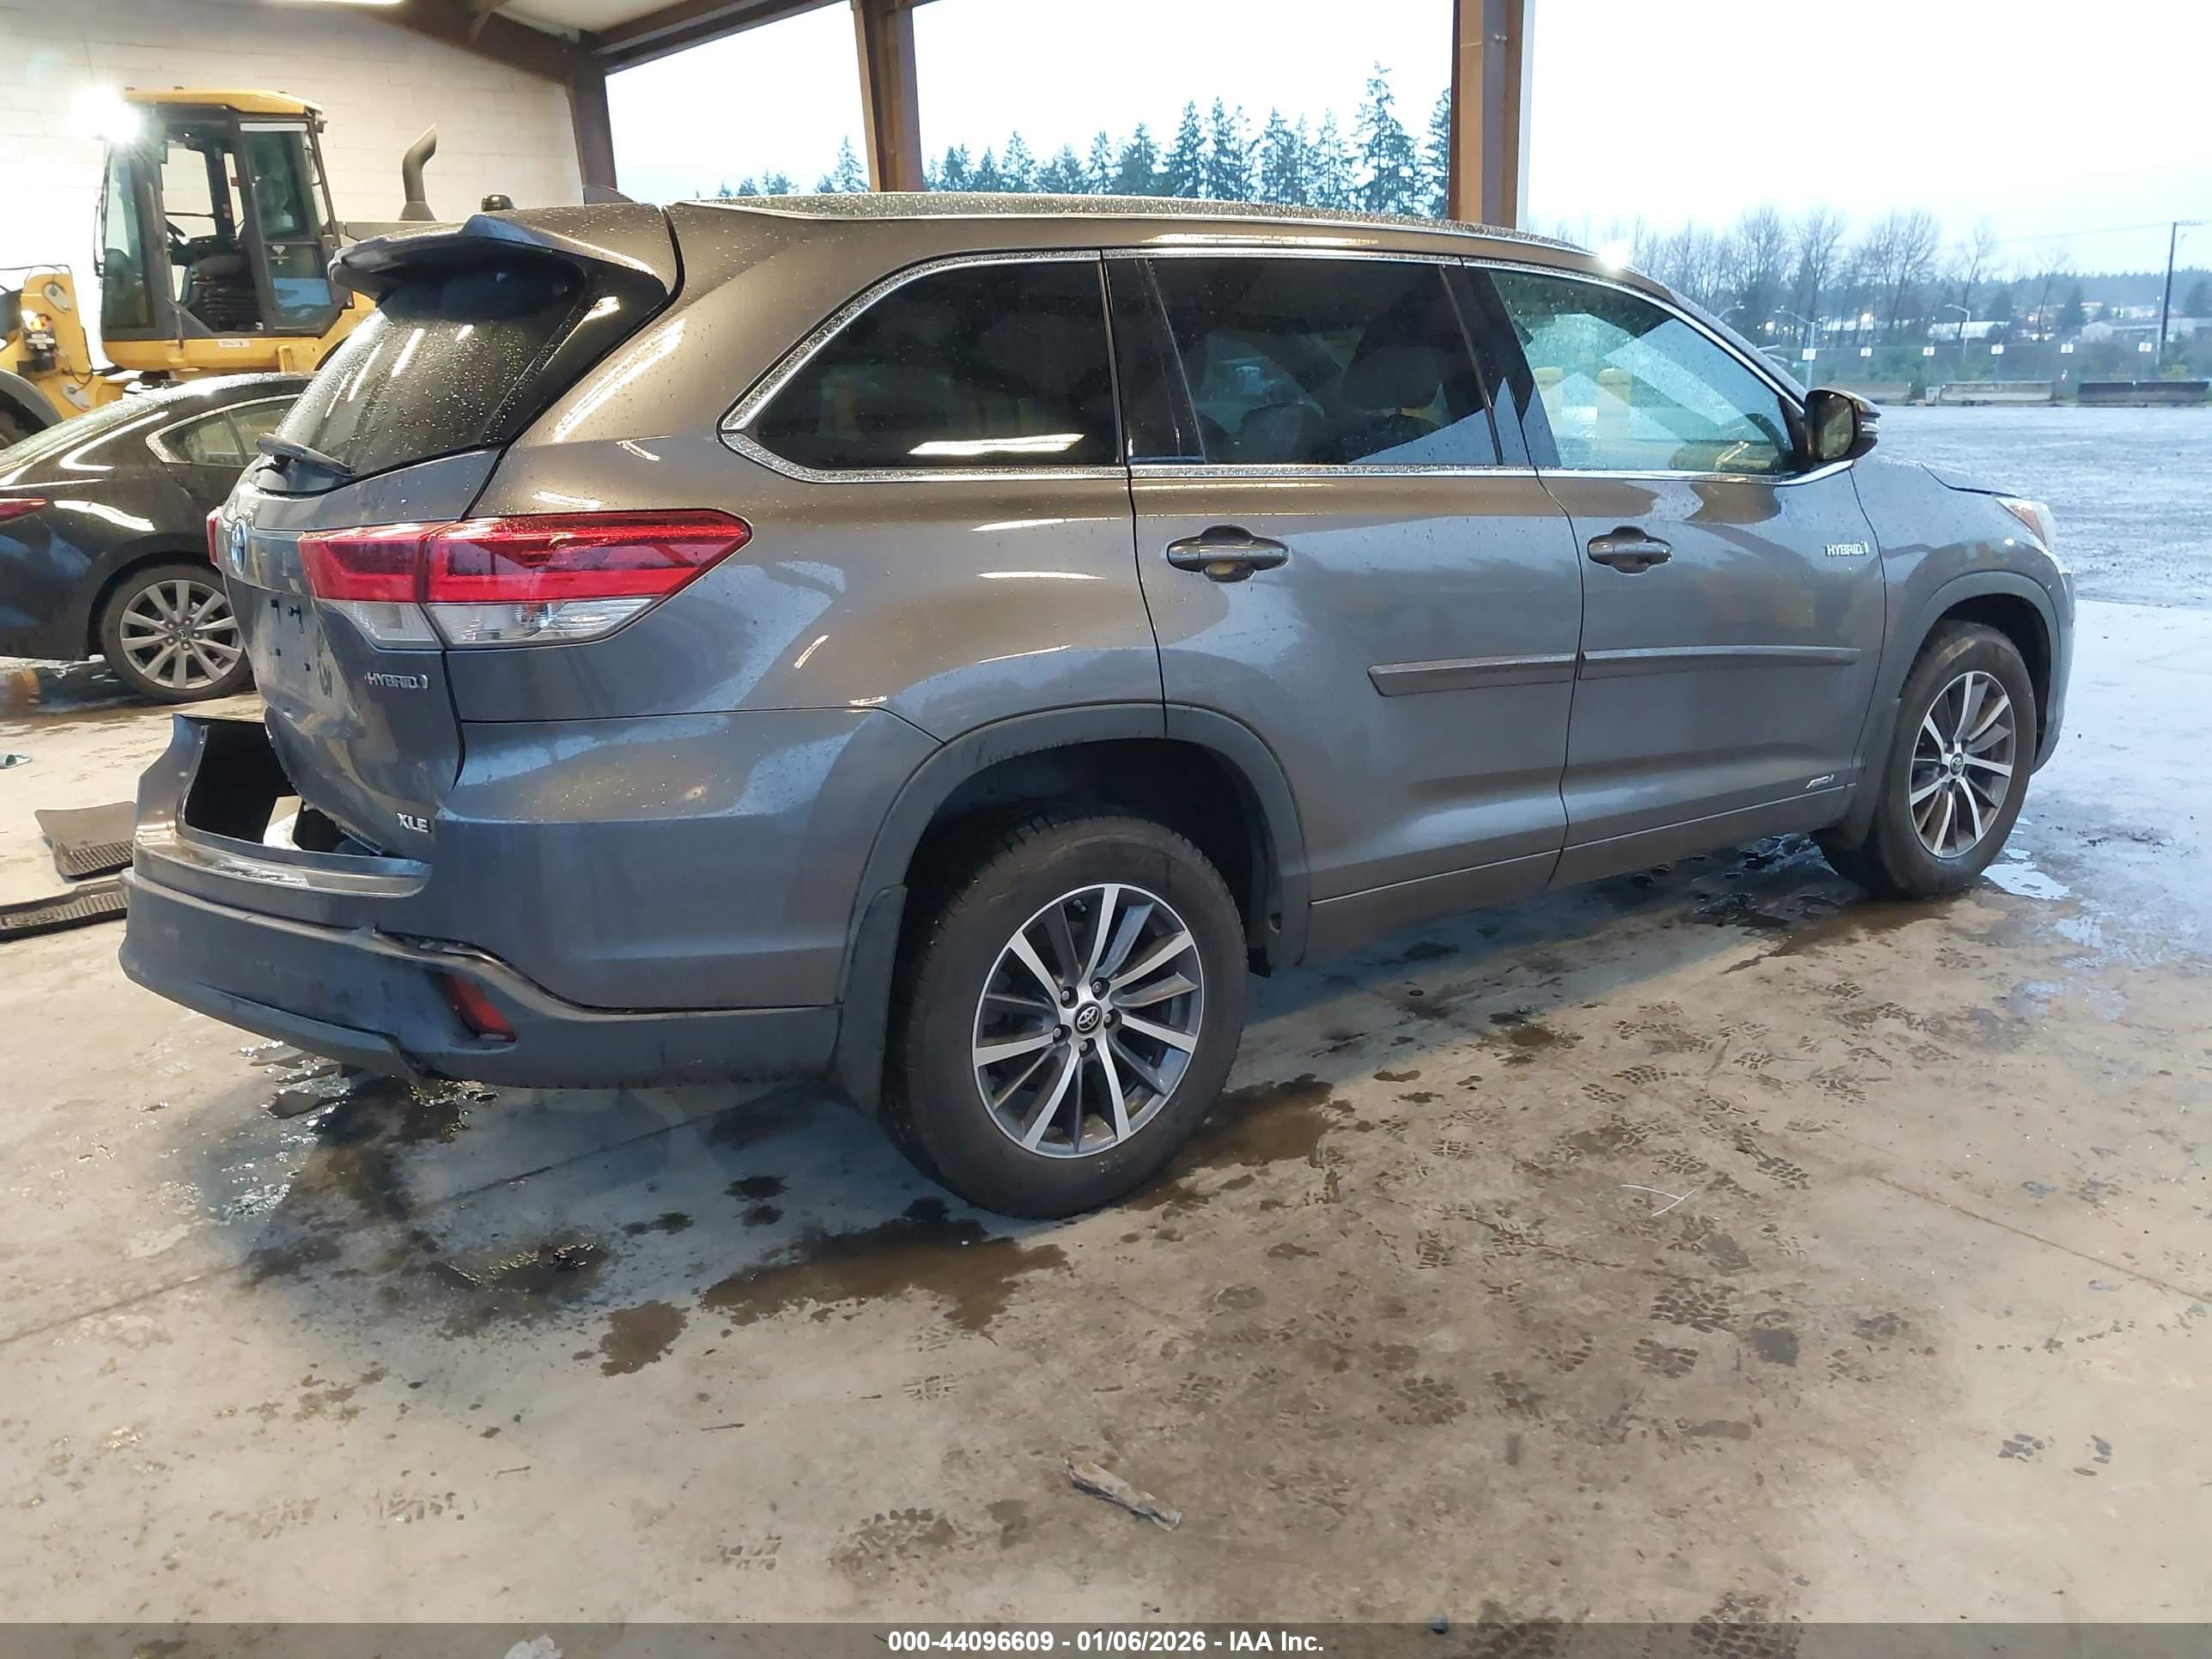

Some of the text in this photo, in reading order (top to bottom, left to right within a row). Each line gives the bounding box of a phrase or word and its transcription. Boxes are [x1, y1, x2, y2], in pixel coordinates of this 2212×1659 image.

[1826, 543, 1862, 556] HYBRID
[366, 672, 418, 690] HYBRID
[396, 811, 429, 834] XLE
